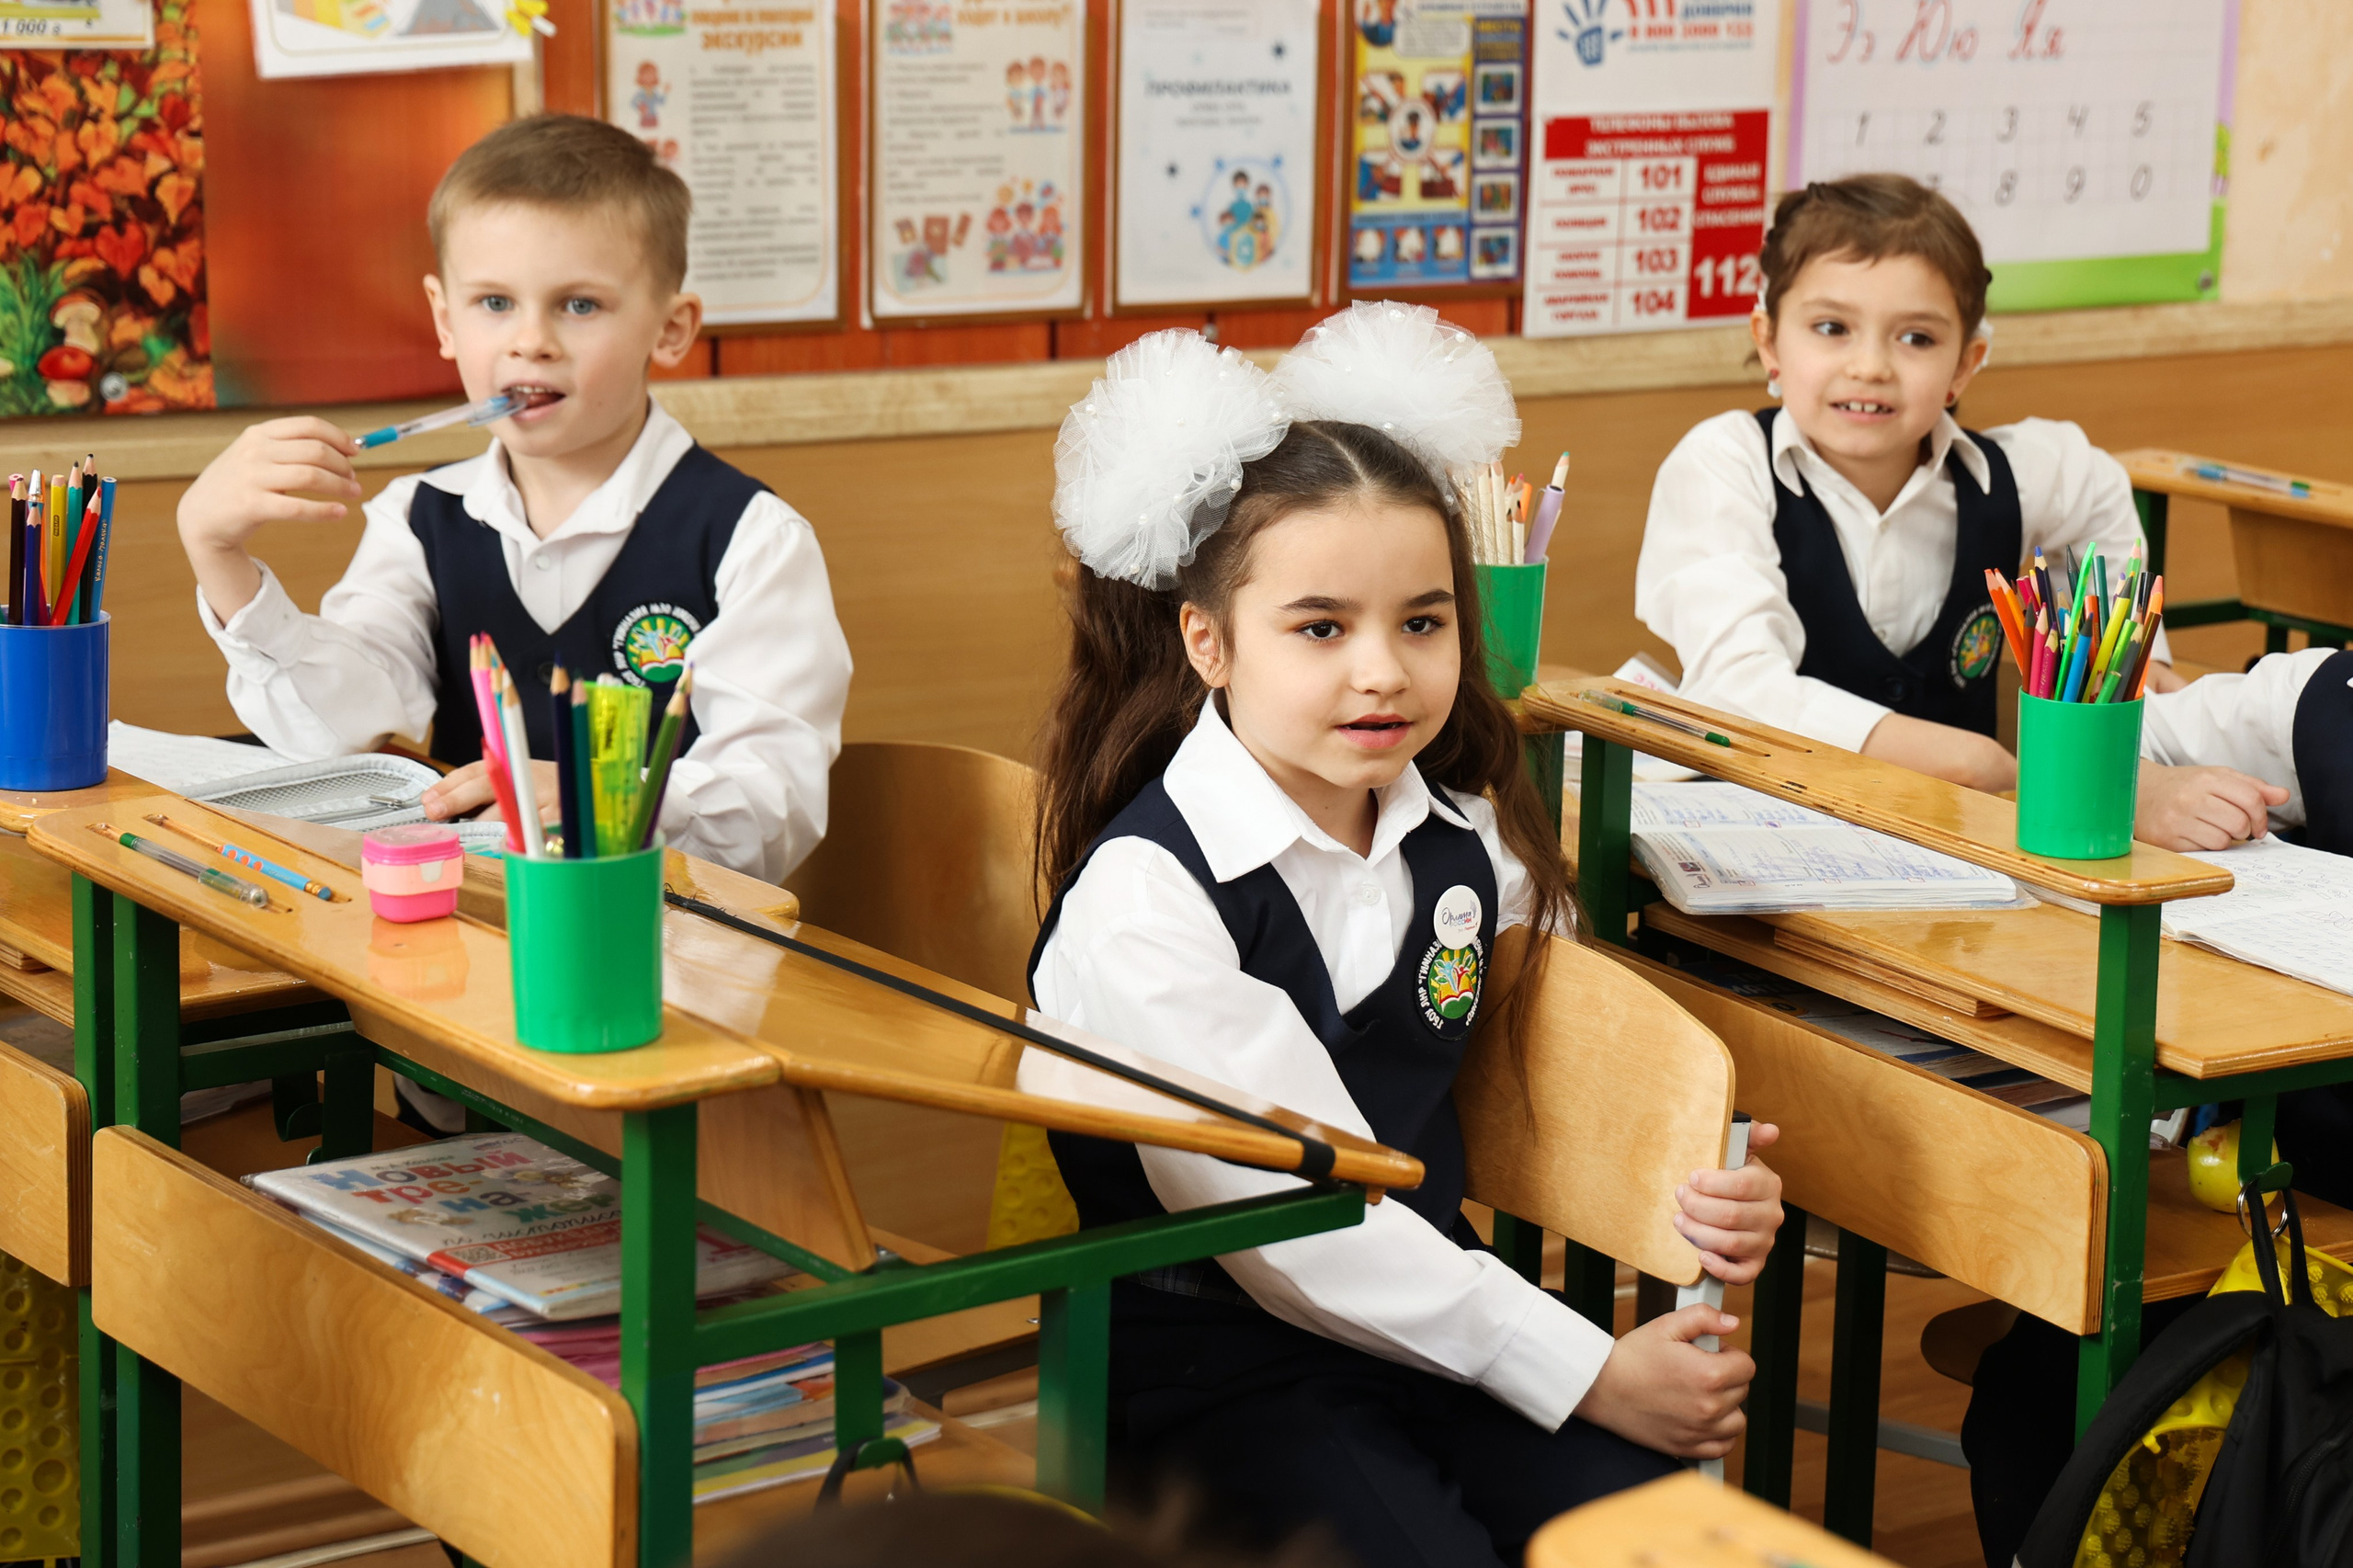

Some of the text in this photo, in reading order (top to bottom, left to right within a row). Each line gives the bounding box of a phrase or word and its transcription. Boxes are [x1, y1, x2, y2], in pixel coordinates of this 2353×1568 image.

[1855, 99, 2155, 147] 1 2 3 4 5
[1640, 165, 1683, 190] 101
[1994, 164, 2154, 208] 8 9 0
[1637, 207, 1681, 232] 102
[1635, 248, 1678, 274] 103
[1694, 255, 1759, 299] 112
[1631, 290, 1675, 316] 104
[1417, 938, 1442, 984] "ГИМНАЗ
[1417, 986, 1430, 1007] ЛНР
[1425, 1008, 1445, 1029] ГБОУ
[309, 1149, 533, 1190] Новый
